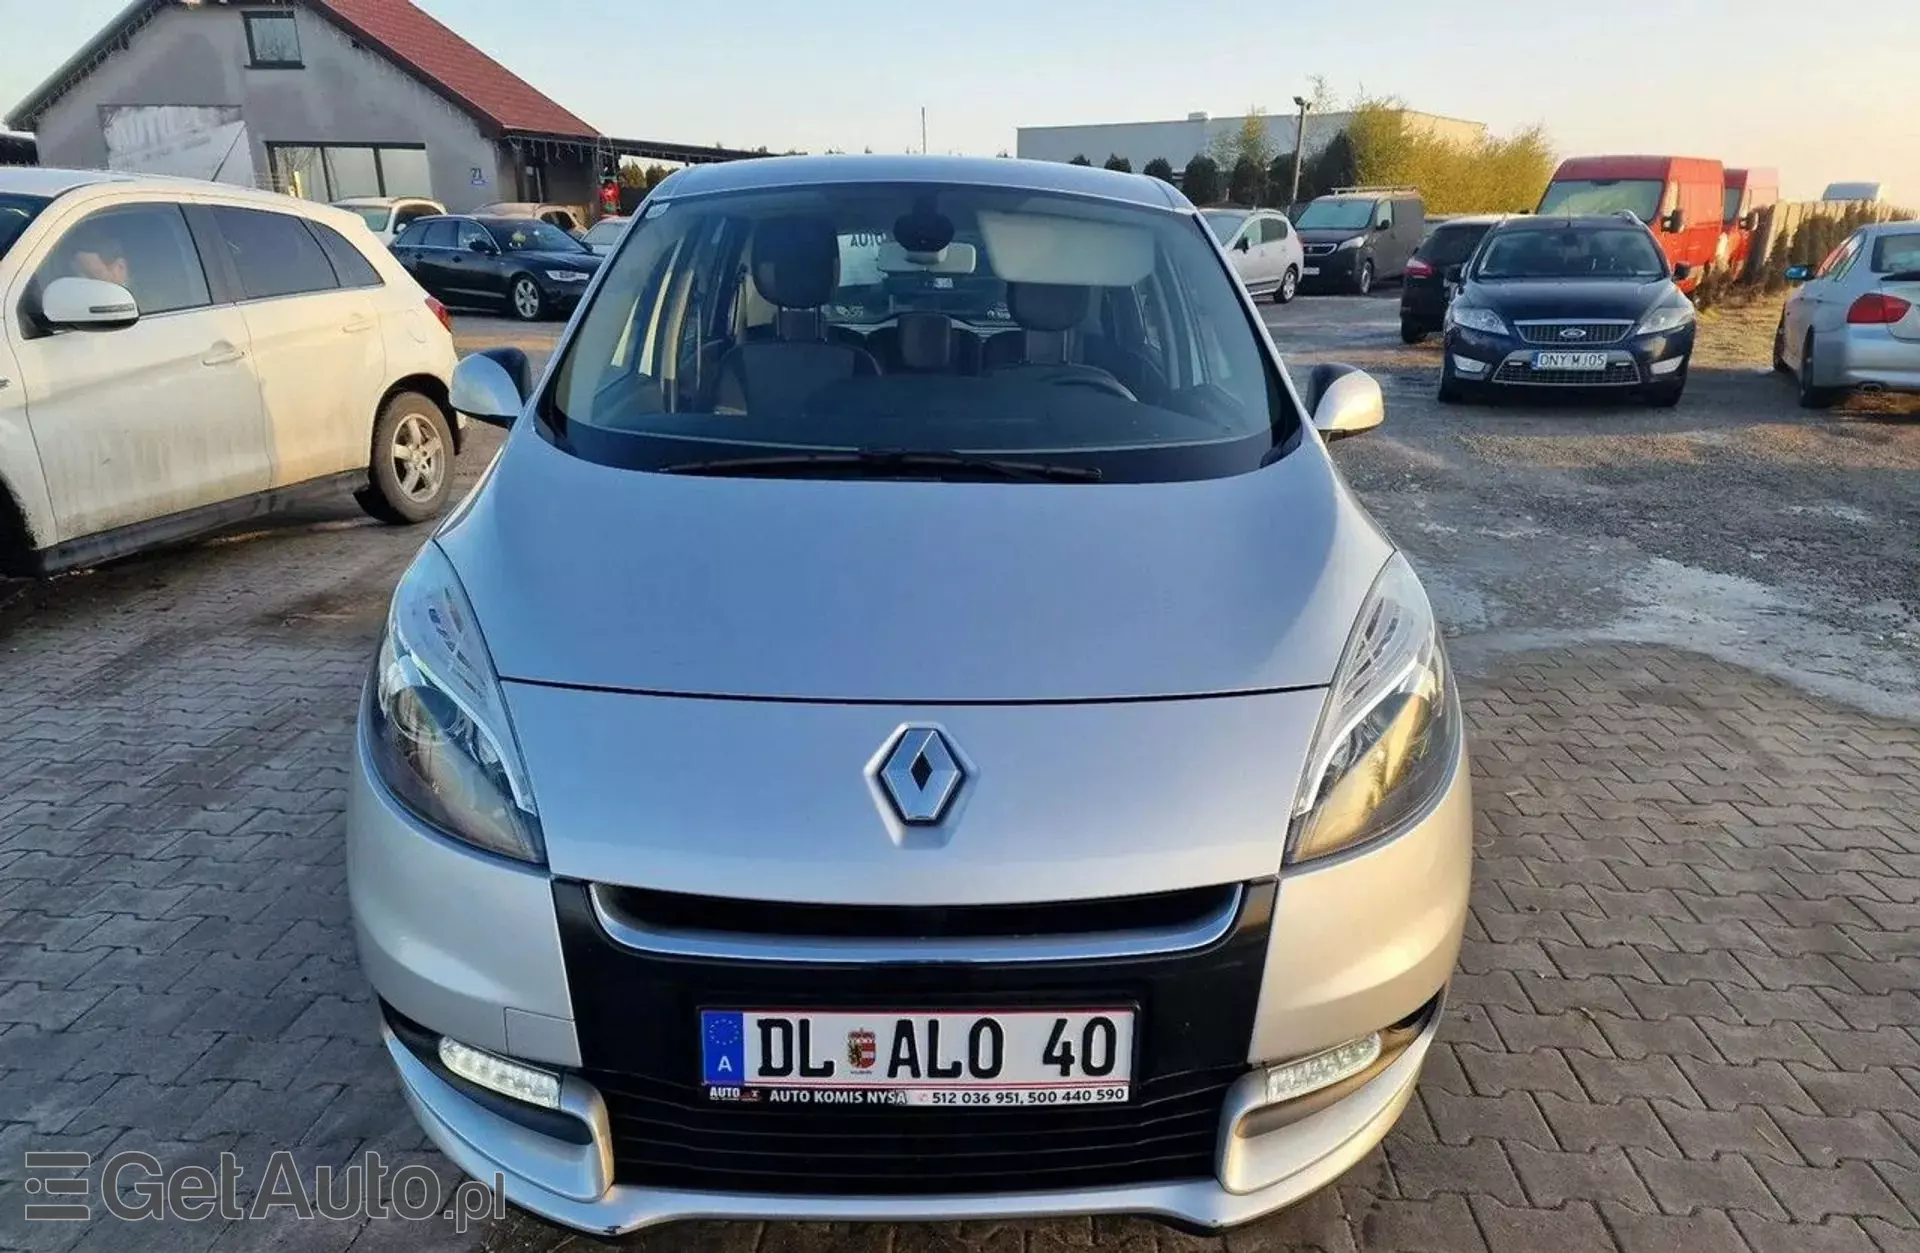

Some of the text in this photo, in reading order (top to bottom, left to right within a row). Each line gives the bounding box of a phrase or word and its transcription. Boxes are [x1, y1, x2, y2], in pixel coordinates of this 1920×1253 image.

[757, 1016, 1117, 1079] DL ALO 40
[717, 1055, 732, 1072] A
[710, 1086, 740, 1098] AUTO
[770, 1090, 810, 1102] AUTO
[814, 1091, 863, 1103] KOMIS
[867, 1091, 906, 1104] NYSA
[932, 1092, 957, 1104] 512
[961, 1092, 990, 1104] 036
[1028, 1091, 1057, 1103] 500
[1062, 1090, 1092, 1102] 440
[1096, 1088, 1125, 1100] 590
